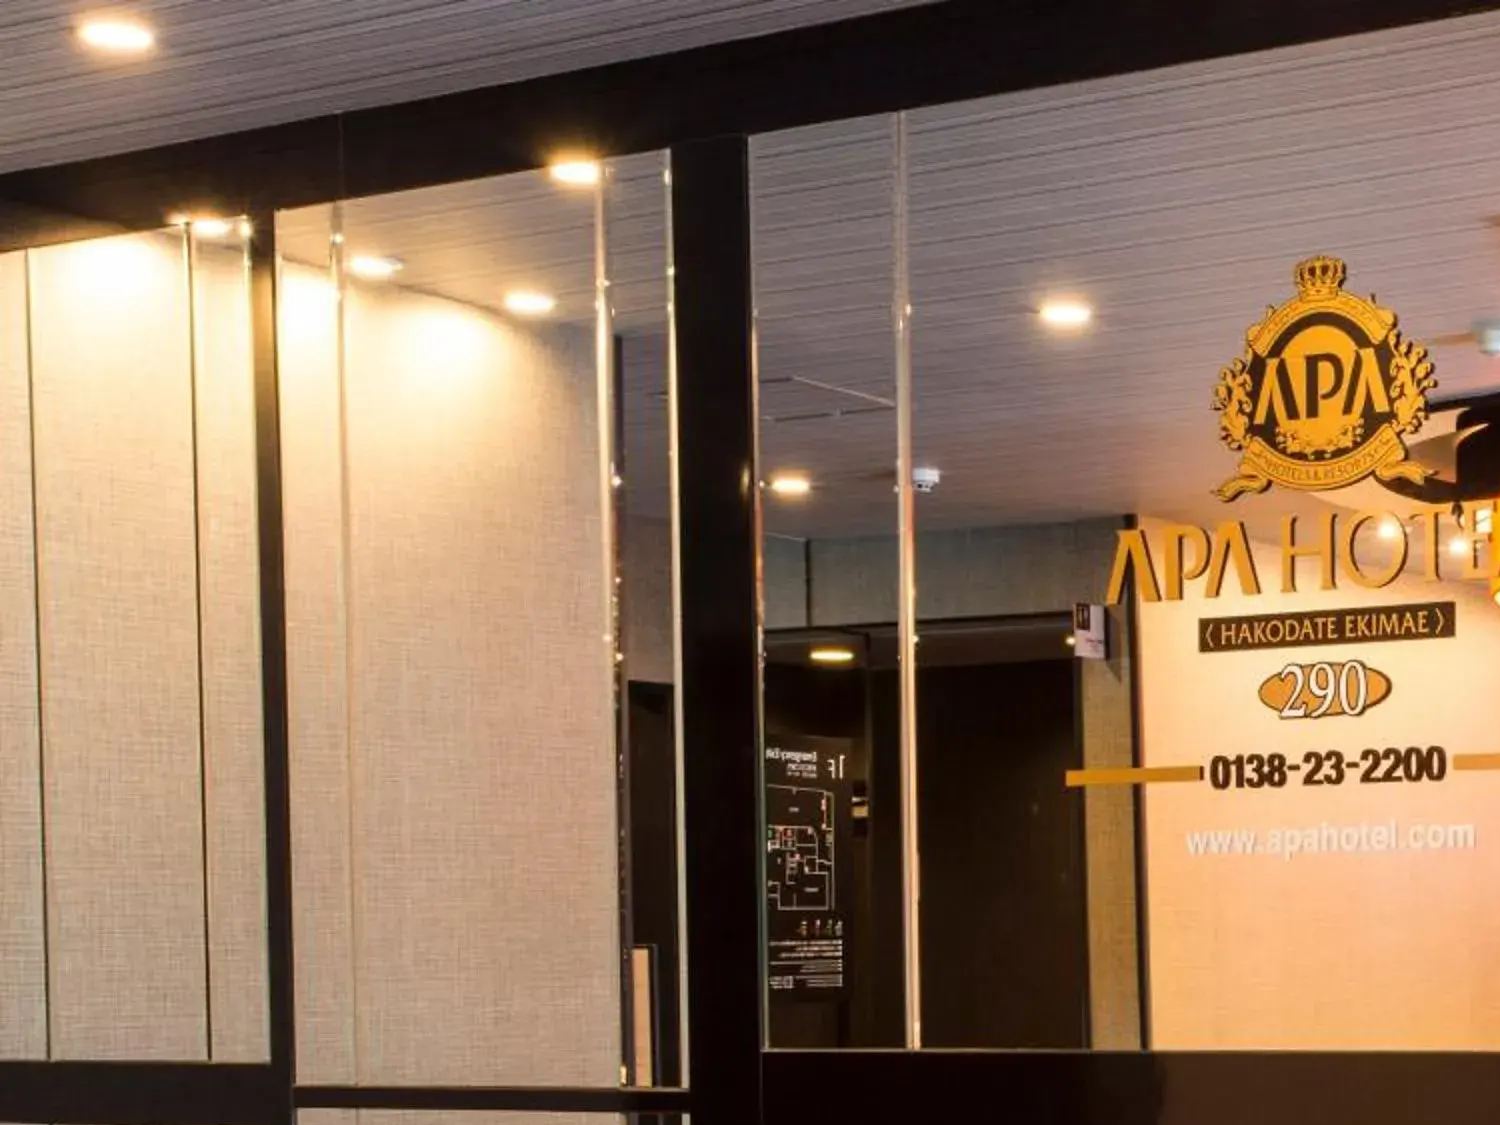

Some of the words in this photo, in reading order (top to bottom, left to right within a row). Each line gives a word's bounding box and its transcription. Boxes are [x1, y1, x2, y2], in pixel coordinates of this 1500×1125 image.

[1252, 348, 1391, 426] APA
[1107, 520, 1262, 606] APA
[1278, 659, 1369, 720] 290
[1209, 745, 1447, 790] 0138-23-2200
[1186, 818, 1476, 862] www.apahotel.com
